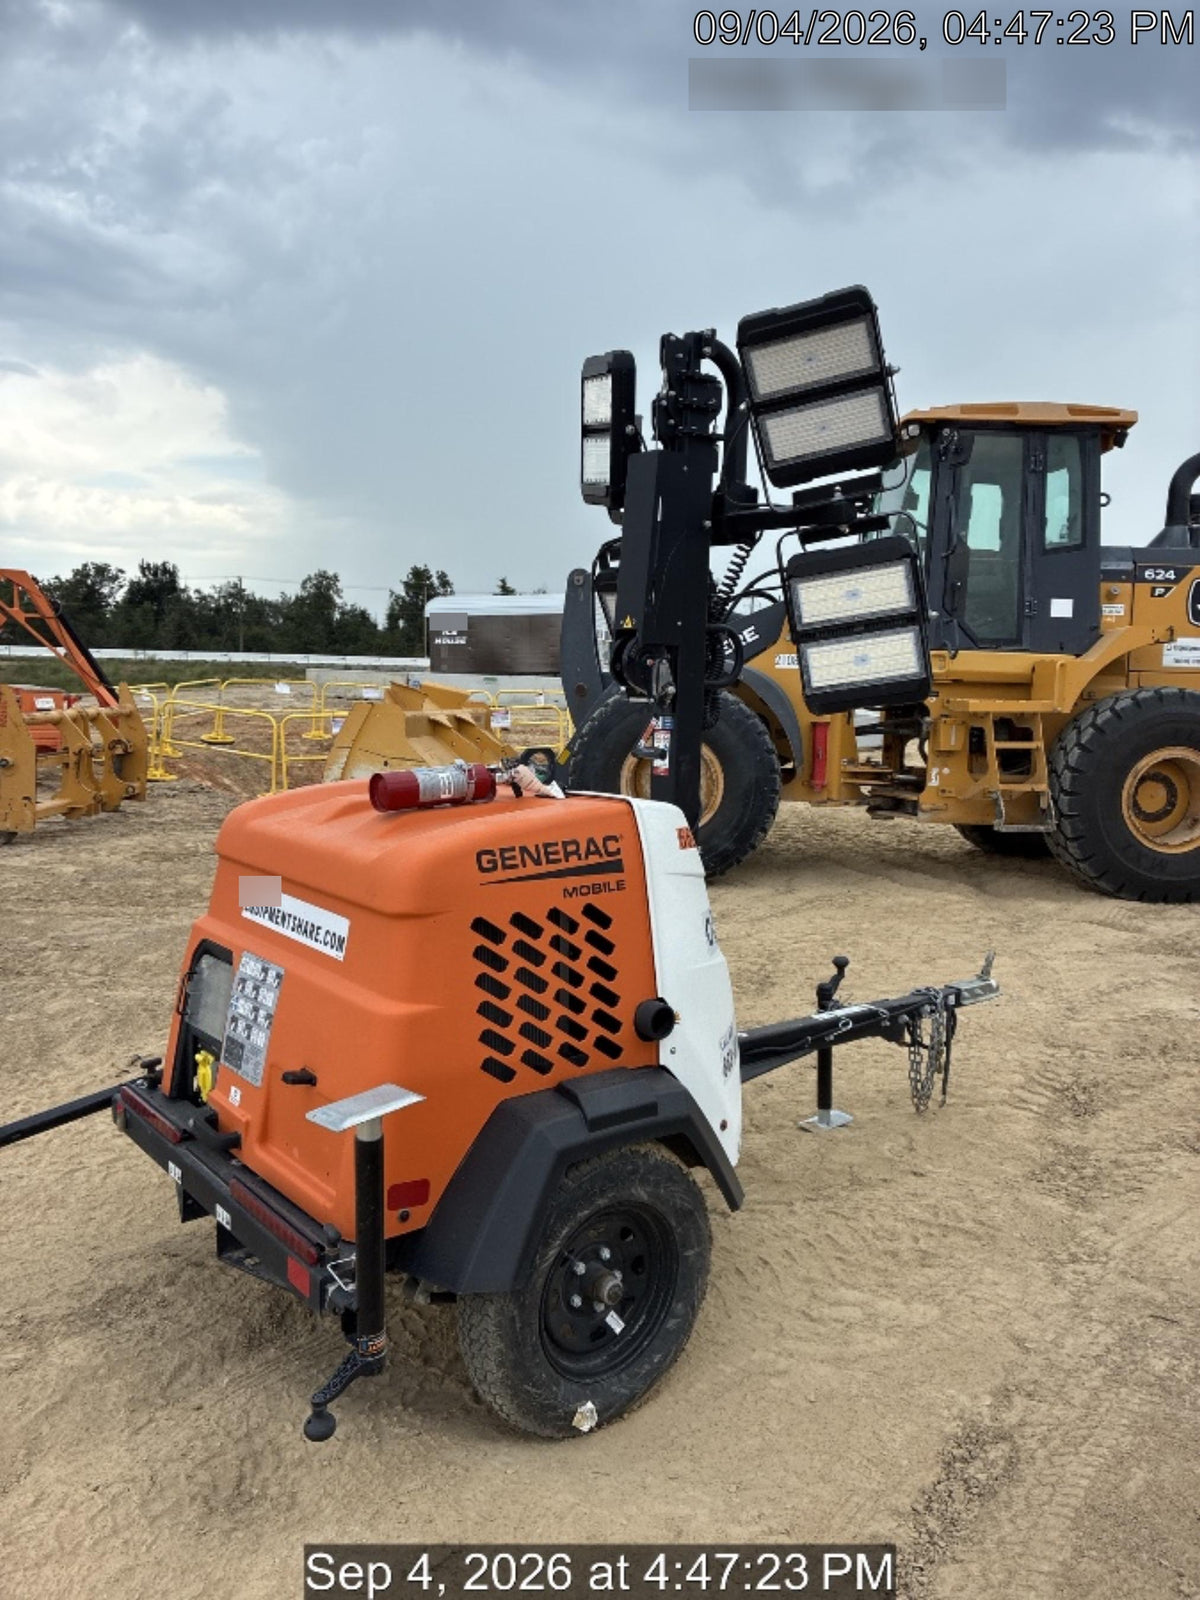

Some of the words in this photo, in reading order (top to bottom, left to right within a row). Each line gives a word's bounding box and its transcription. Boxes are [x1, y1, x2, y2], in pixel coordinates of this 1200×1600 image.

[1144, 568, 1176, 581] 624
[476, 834, 622, 874] GENERAC
[562, 879, 626, 899] MOBILE
